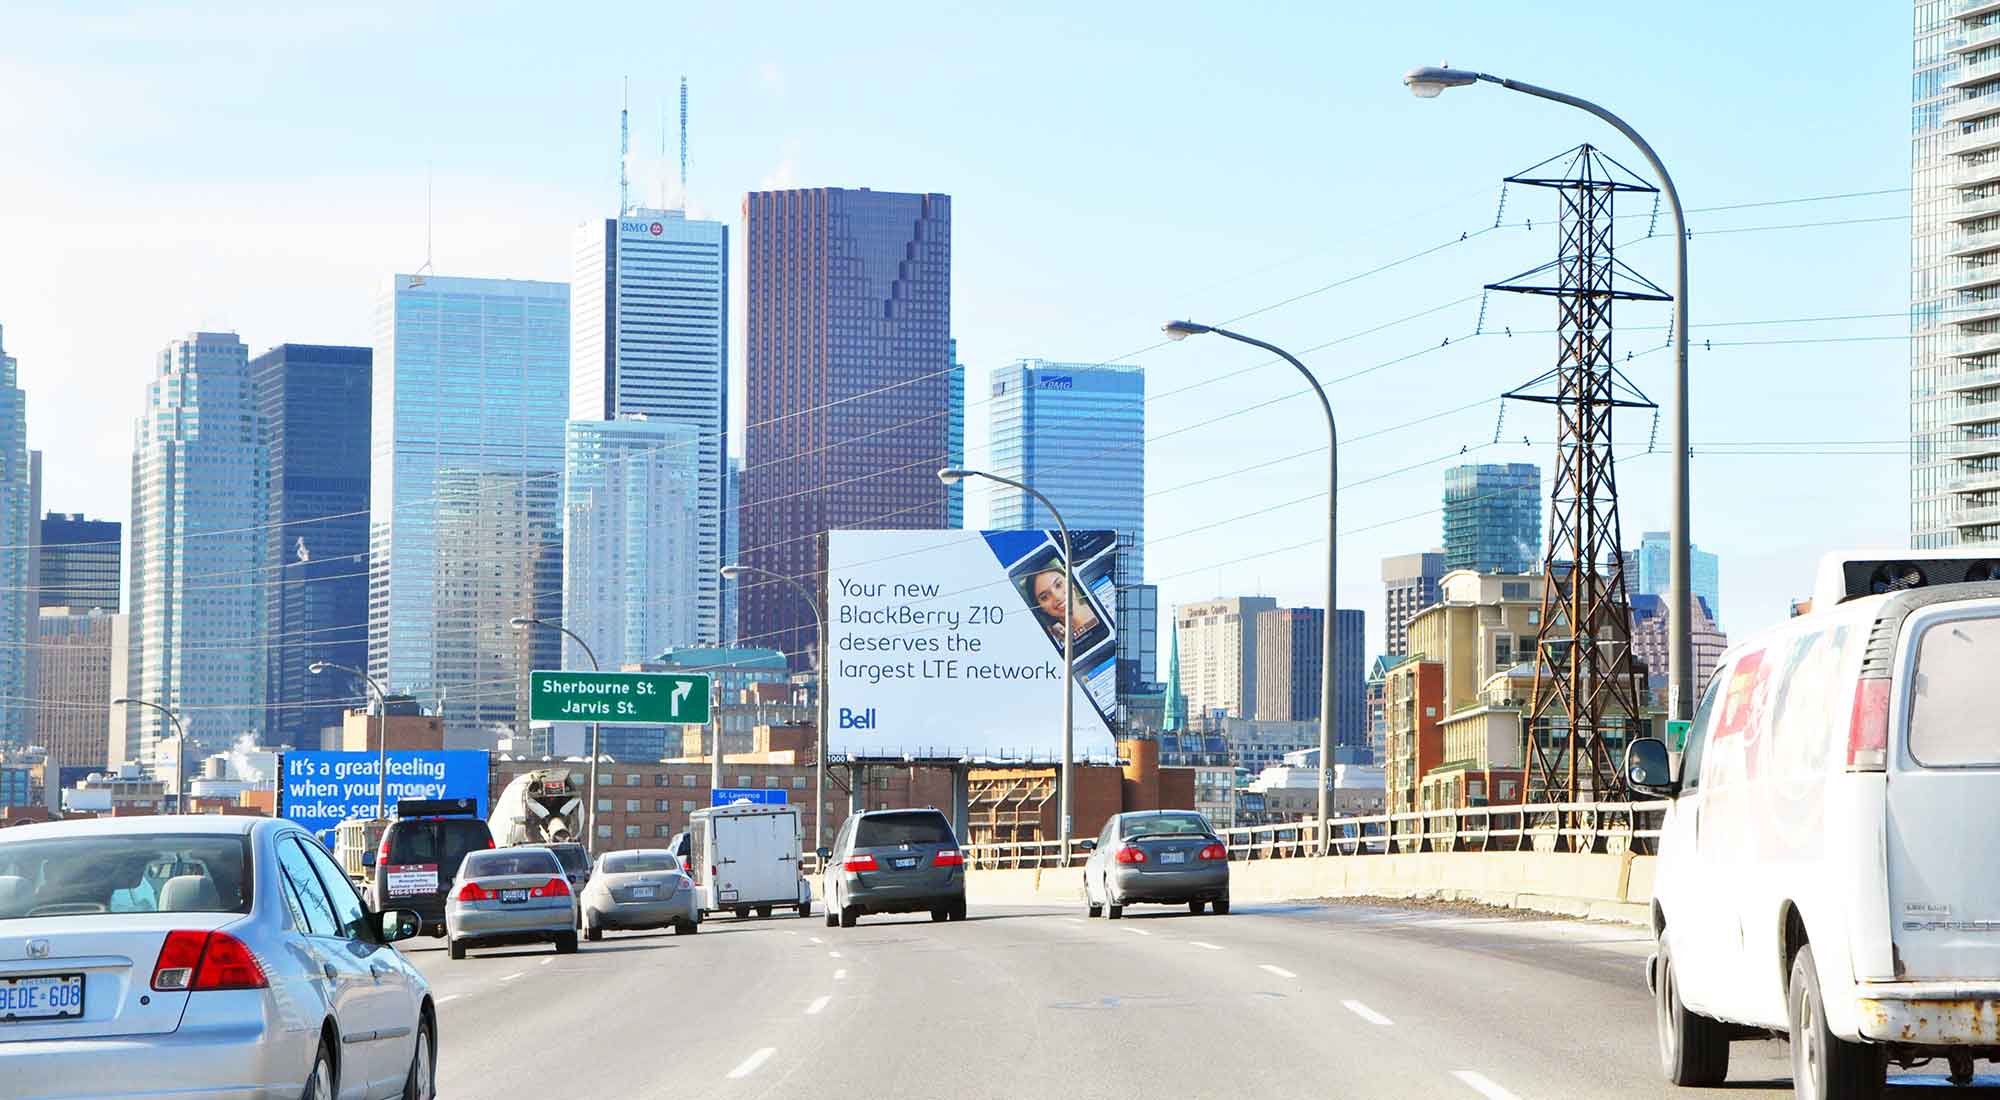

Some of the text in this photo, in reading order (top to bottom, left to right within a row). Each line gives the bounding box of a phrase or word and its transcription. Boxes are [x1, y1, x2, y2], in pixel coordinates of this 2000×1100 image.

[622, 222, 648, 233] BMO
[838, 578, 940, 598] Your new
[840, 604, 1004, 631] BlackBerry Z10
[838, 632, 982, 652] deserves the
[839, 659, 1063, 684] largest LTE network.
[542, 680, 657, 695] Sherbourne St.
[561, 700, 637, 714] Jarvis St.
[839, 707, 876, 729] Bell
[290, 757, 446, 780] It's a great feeling
[290, 780, 338, 796] when
[386, 783, 446, 800] money
[290, 801, 345, 818] makes
